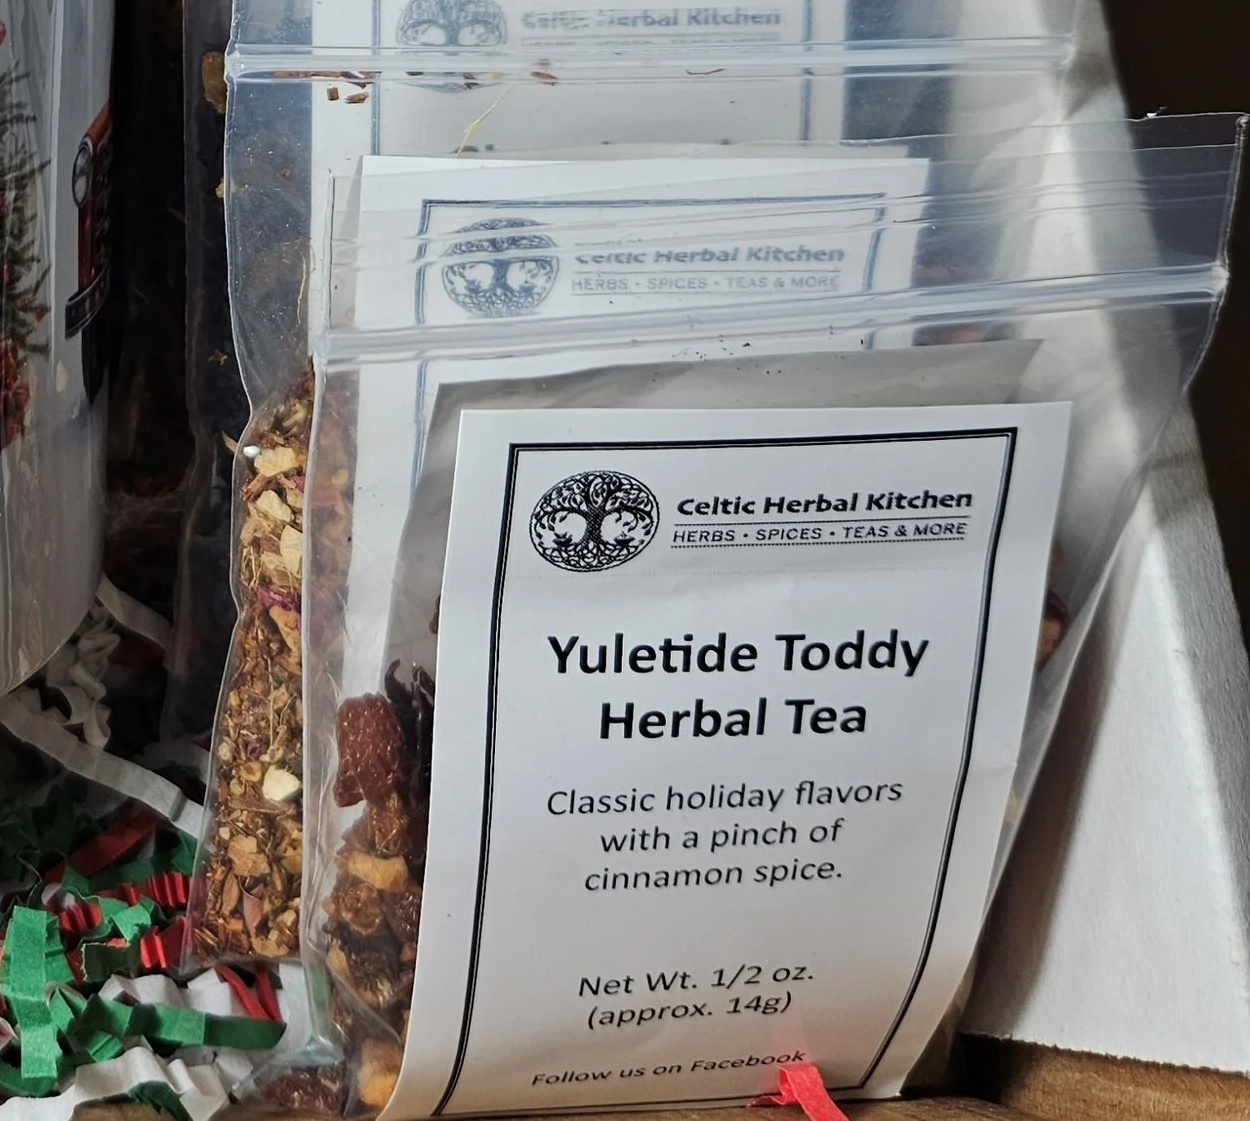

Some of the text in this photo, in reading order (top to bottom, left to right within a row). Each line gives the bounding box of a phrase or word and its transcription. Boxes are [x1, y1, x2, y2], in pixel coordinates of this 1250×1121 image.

[687, 7, 781, 26] Kitchen
[654, 247, 739, 263] Herbal
[746, 246, 845, 262] Kitchen
[572, 278, 628, 291] HERBS
[647, 277, 707, 290] SPICES
[726, 276, 767, 288] TEAS
[791, 276, 839, 288] MORE
[677, 490, 972, 516] Celtic Herbal Kitchen
[672, 523, 967, 542] HERBS SPICES TEAS & MORE
[548, 629, 929, 677] Yuletide Toddy
[600, 697, 867, 739] Herbal Tea
[548, 780, 903, 815] Classic holiday flavors
[600, 818, 845, 853] with a pinch of
[585, 859, 842, 891] cinnamon spice.
[579, 964, 814, 997] Net Wt. 1/2 oz.
[588, 991, 792, 1029] (approx. 14g)
[532, 1050, 806, 1086] Follow us on Facebook
